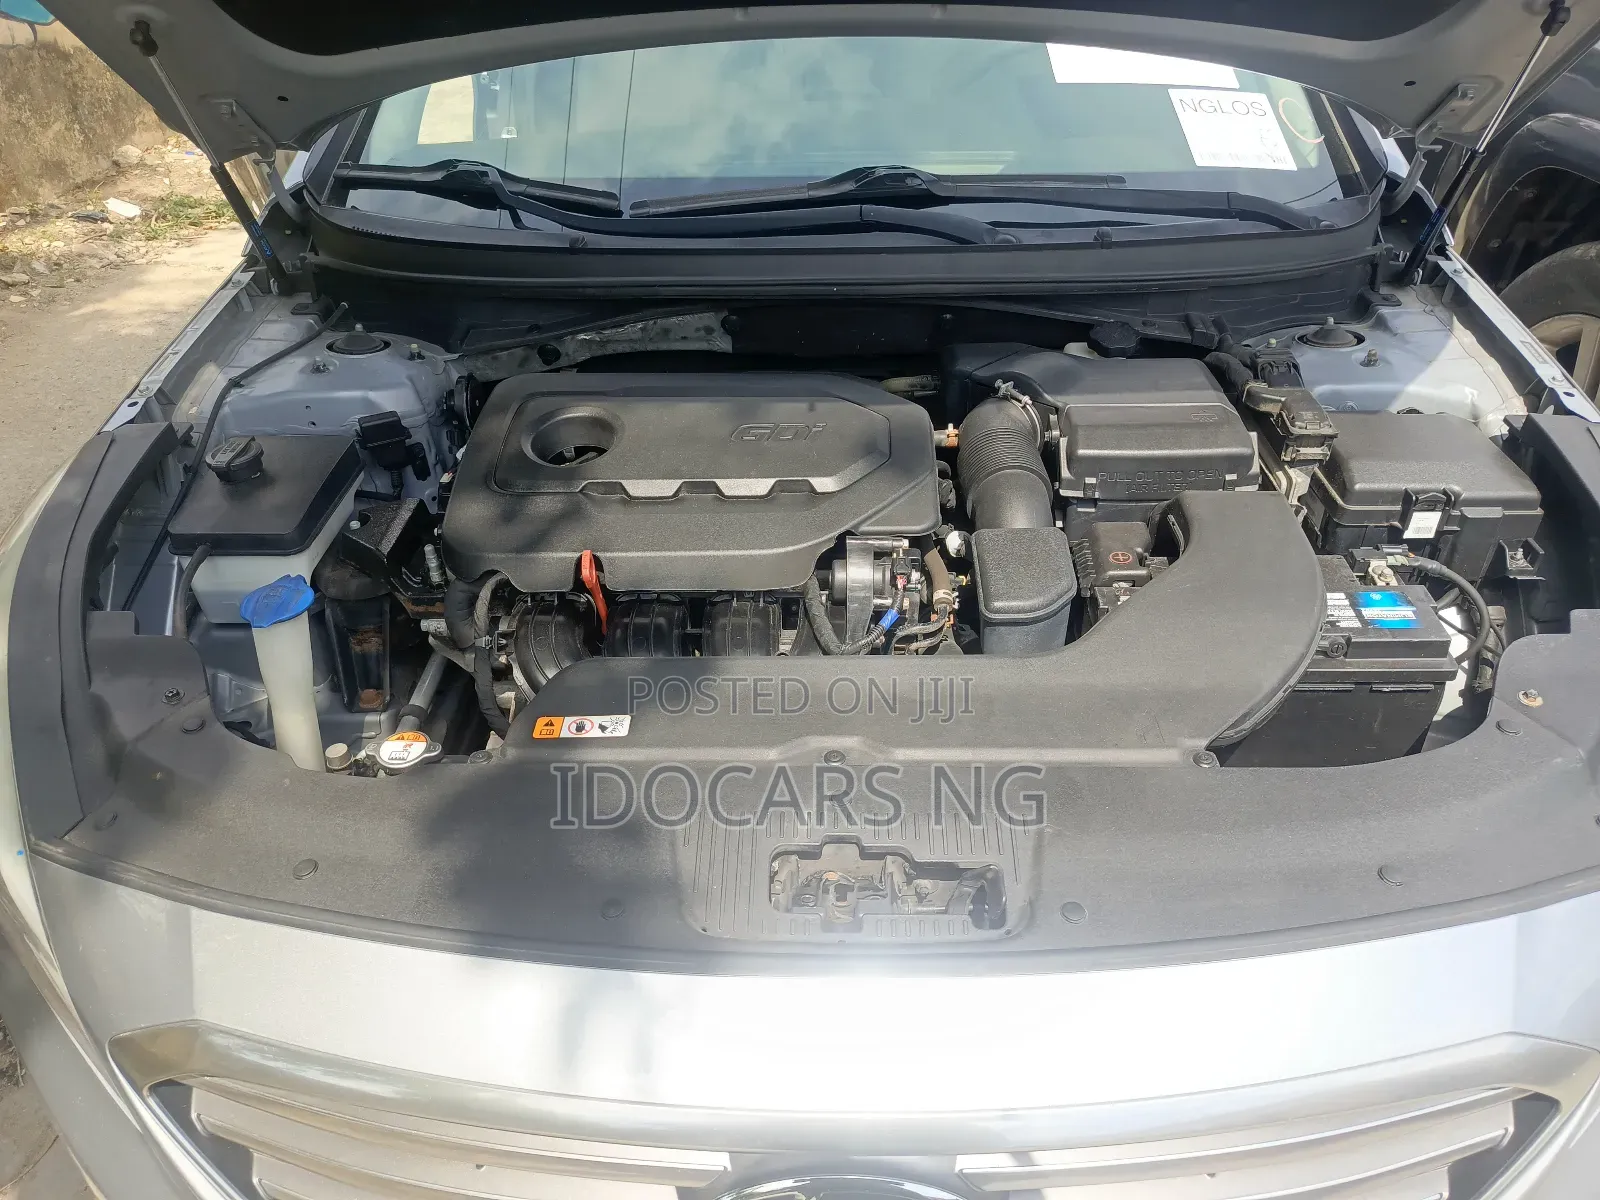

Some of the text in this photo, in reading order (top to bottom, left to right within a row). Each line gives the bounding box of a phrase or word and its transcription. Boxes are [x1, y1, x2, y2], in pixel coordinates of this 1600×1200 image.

[1178, 98, 1267, 117] NGLOS
[1098, 469, 1223, 482] PULL OUT TO OPEN
